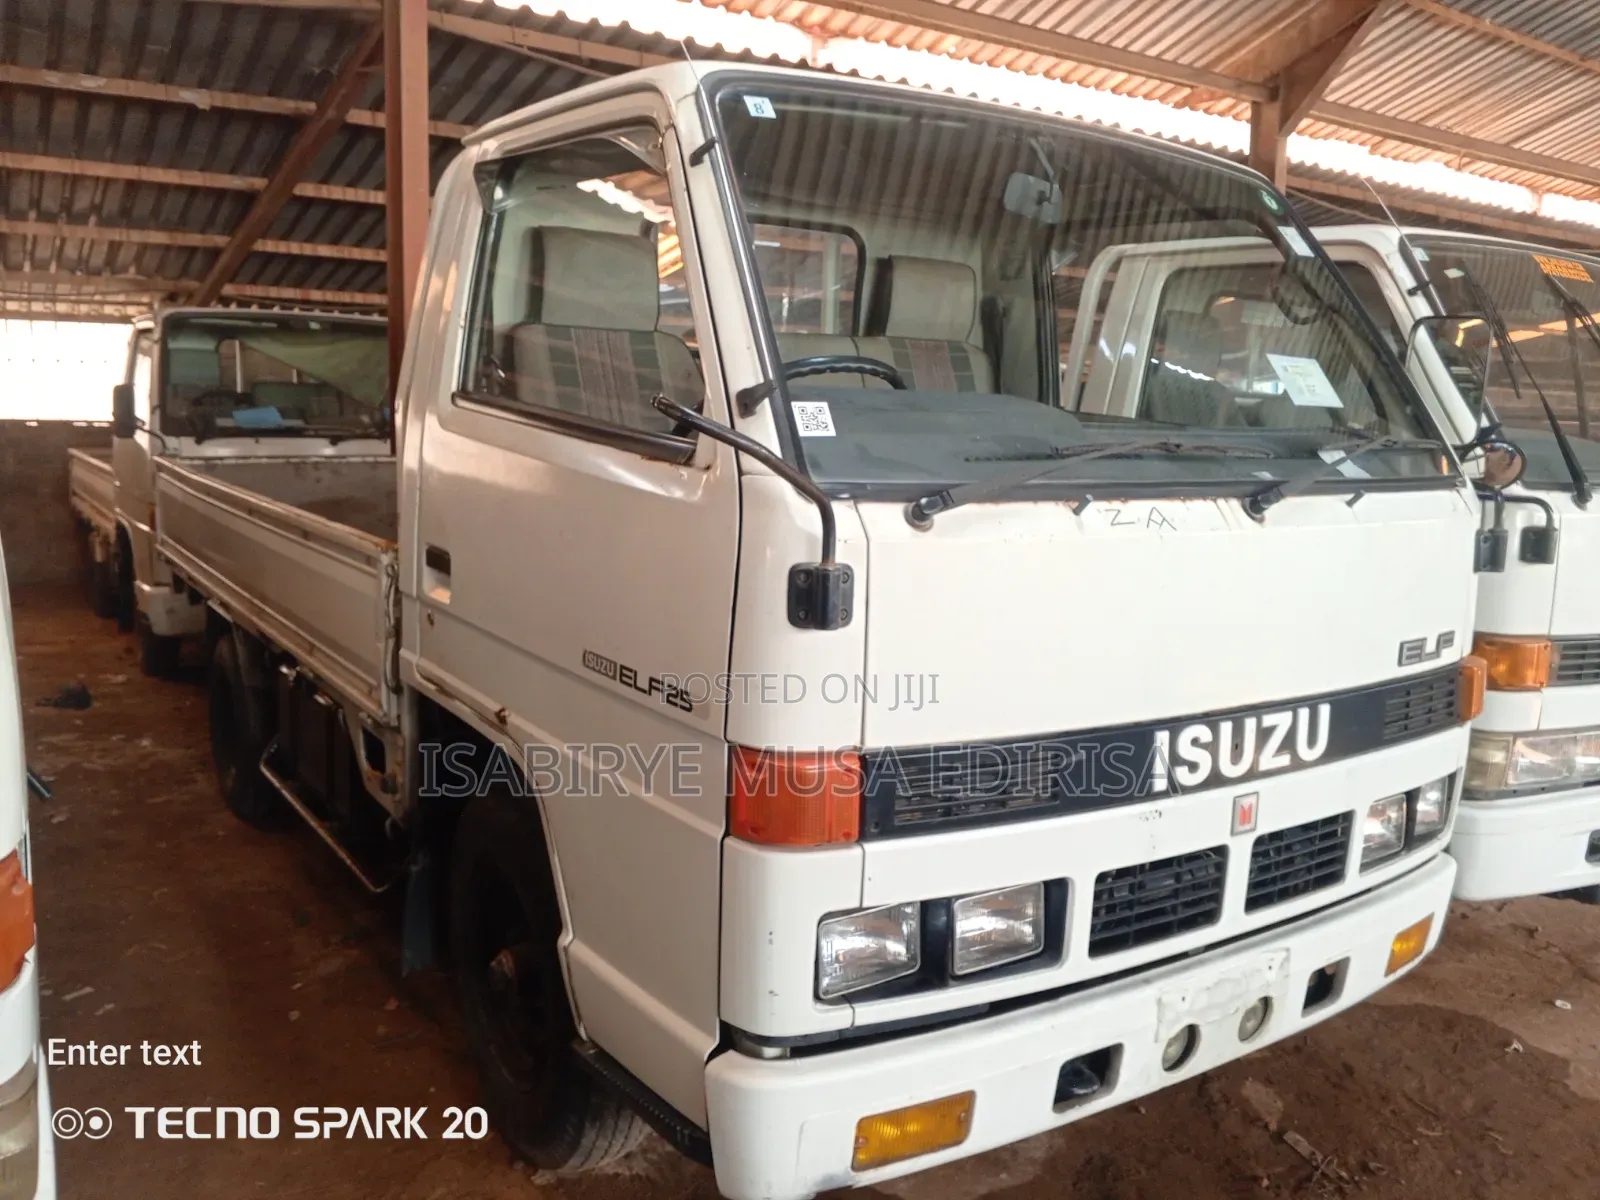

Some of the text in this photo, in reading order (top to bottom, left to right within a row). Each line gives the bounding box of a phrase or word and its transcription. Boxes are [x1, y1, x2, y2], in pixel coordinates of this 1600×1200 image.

[583, 650, 617, 680] ISUZU
[1397, 630, 1455, 667] ELF
[1150, 702, 1331, 793] ISUZU
